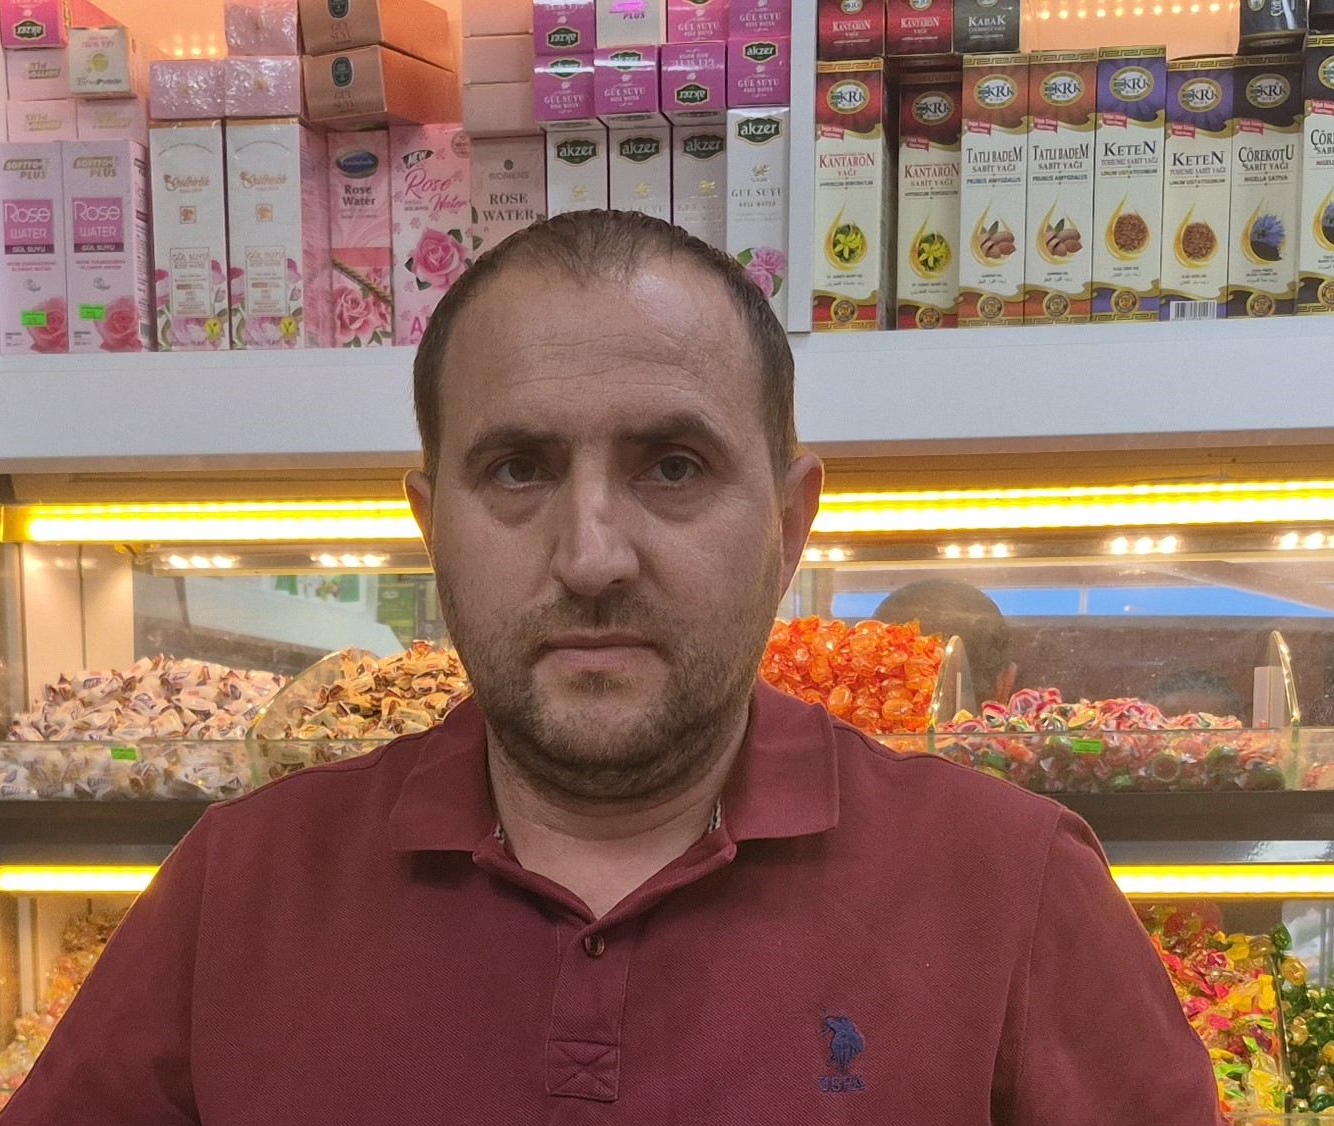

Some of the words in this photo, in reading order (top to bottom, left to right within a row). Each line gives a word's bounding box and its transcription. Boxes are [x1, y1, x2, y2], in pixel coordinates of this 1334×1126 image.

[623, 12, 645, 20] PLUS
[968, 15, 1006, 26] KABAK
[746, 46, 775, 56] akzer
[740, 121, 778, 136] akzer
[559, 144, 595, 157] akzer
[622, 141, 657, 155] akzer
[685, 138, 722, 152] akzer
[1058, 143, 1089, 160] BADEM
[1103, 140, 1156, 157] KETEN
[406, 150, 429, 166] NEW
[819, 152, 875, 169] KANTARON
[993, 146, 1023, 163] BADEM
[1172, 151, 1225, 167] KETEN
[1238, 145, 1295, 166] ÇÖREKOTU
[904, 162, 960, 179] KANTARON
[972, 164, 994, 173] SABİT
[995, 163, 1016, 172] YAĞI
[1038, 162, 1060, 170] SABİT
[1062, 160, 1083, 169] YAĞI
[1244, 163, 1268, 171] SABİT
[1269, 162, 1289, 170] YAĞI
[344, 184, 373, 195] Rose
[404, 167, 450, 199] Rose
[342, 195, 375, 207] Water
[429, 193, 466, 212] Water
[489, 193, 529, 205] ROSE
[4, 203, 51, 223] Rose
[74, 201, 120, 222] Rose
[483, 210, 535, 222] WATER
[11, 227, 47, 239] WATER
[80, 226, 117, 238] WATER
